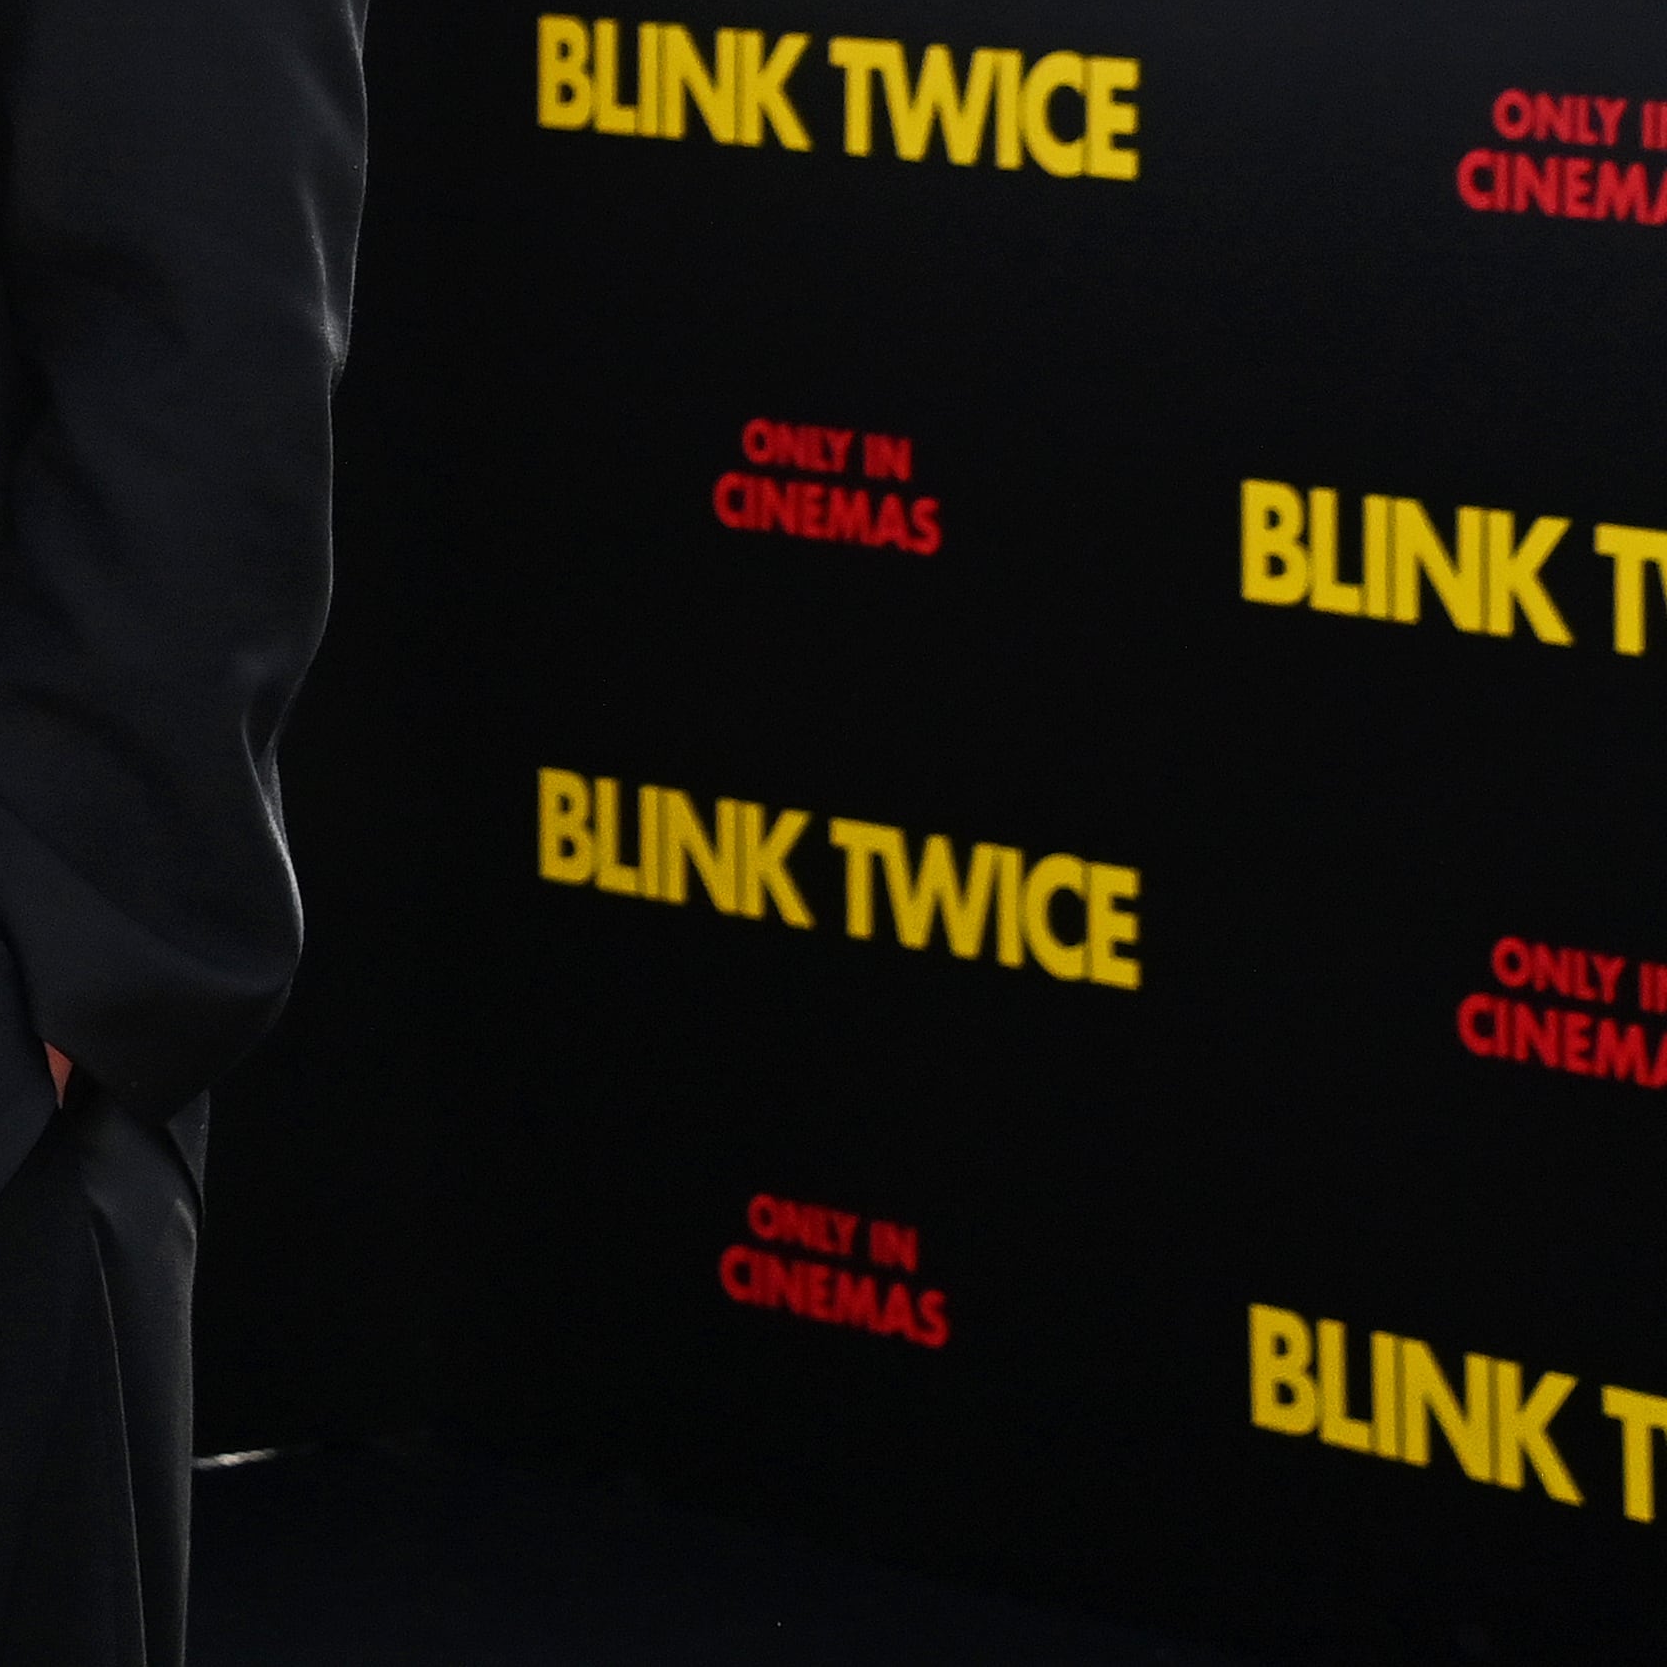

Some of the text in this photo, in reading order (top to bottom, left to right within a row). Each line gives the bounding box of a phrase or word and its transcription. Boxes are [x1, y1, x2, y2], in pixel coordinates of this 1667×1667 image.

[537, 13, 1141, 182] BLINK TWICE
[1492, 87, 1667, 151] ONLY I
[1455, 148, 1667, 226] CINEM
[741, 418, 913, 482] ONLY IN
[713, 471, 942, 556] CINEMAS
[1240, 478, 1573, 646] BLINK
[538, 767, 1141, 990] BLINK TWICE
[1490, 936, 1626, 1005] ONLY
[1457, 993, 1667, 1089] CINEM
[747, 1194, 918, 1271] ONLY IN
[719, 1245, 950, 1348] CINEMAS
[1248, 1303, 1584, 1507] BLINK
